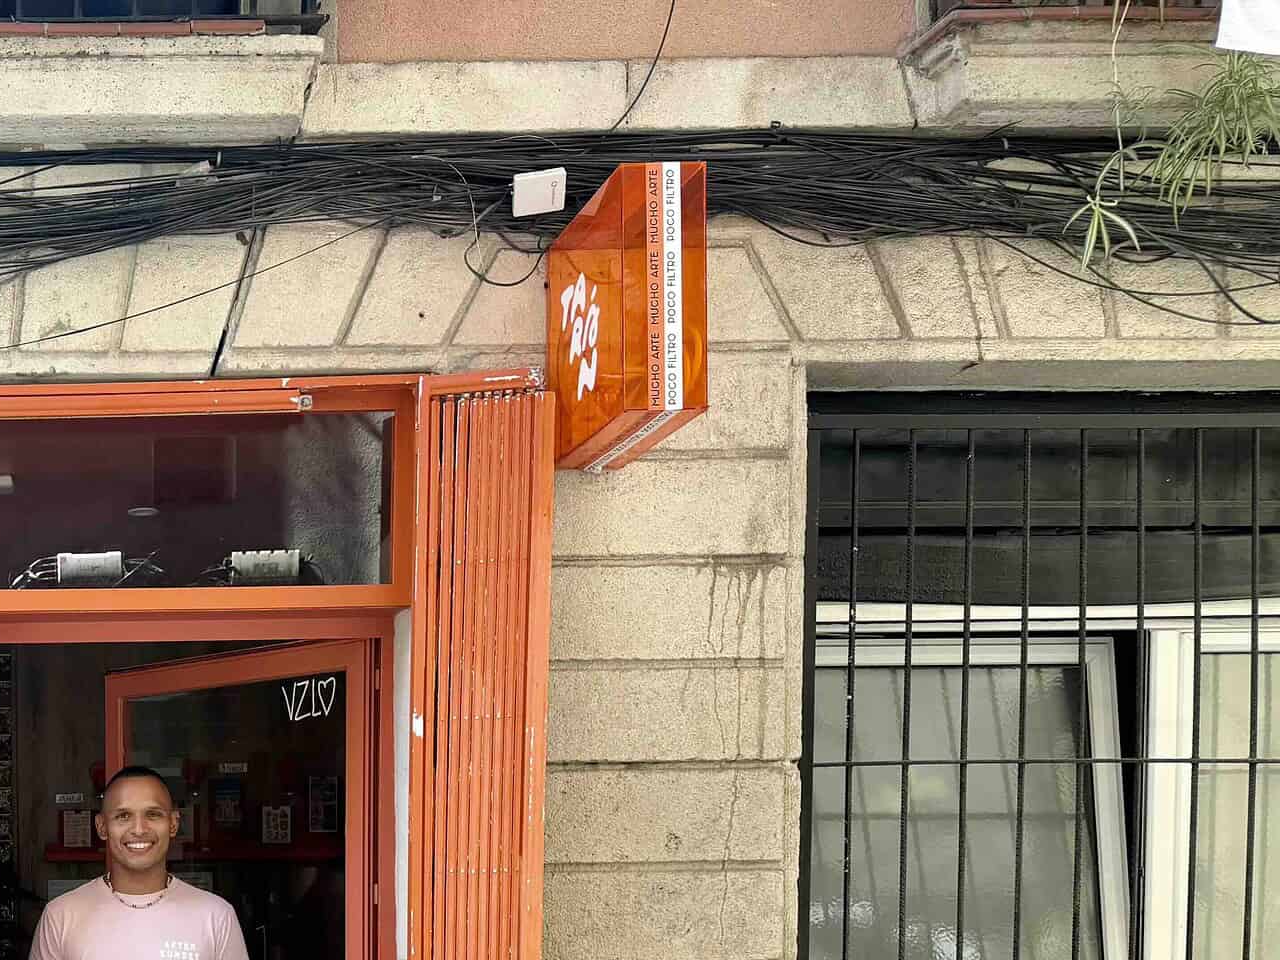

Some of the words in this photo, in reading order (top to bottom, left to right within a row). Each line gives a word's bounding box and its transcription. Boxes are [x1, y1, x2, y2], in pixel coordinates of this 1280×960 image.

[649, 169, 659, 197] ARTE
[666, 168, 676, 205] FILTRO
[649, 200, 659, 244] MUCHO
[666, 209, 676, 242] POCO
[650, 251, 660, 279] ARTE
[667, 251, 677, 287] FILTRO
[650, 282, 660, 325] MUCHO
[667, 291, 677, 324] POCO
[651, 332, 661, 360] ARTE
[668, 332, 678, 369] FILTRO
[651, 363, 661, 407] MUCHO
[668, 372, 678, 406] POCO
